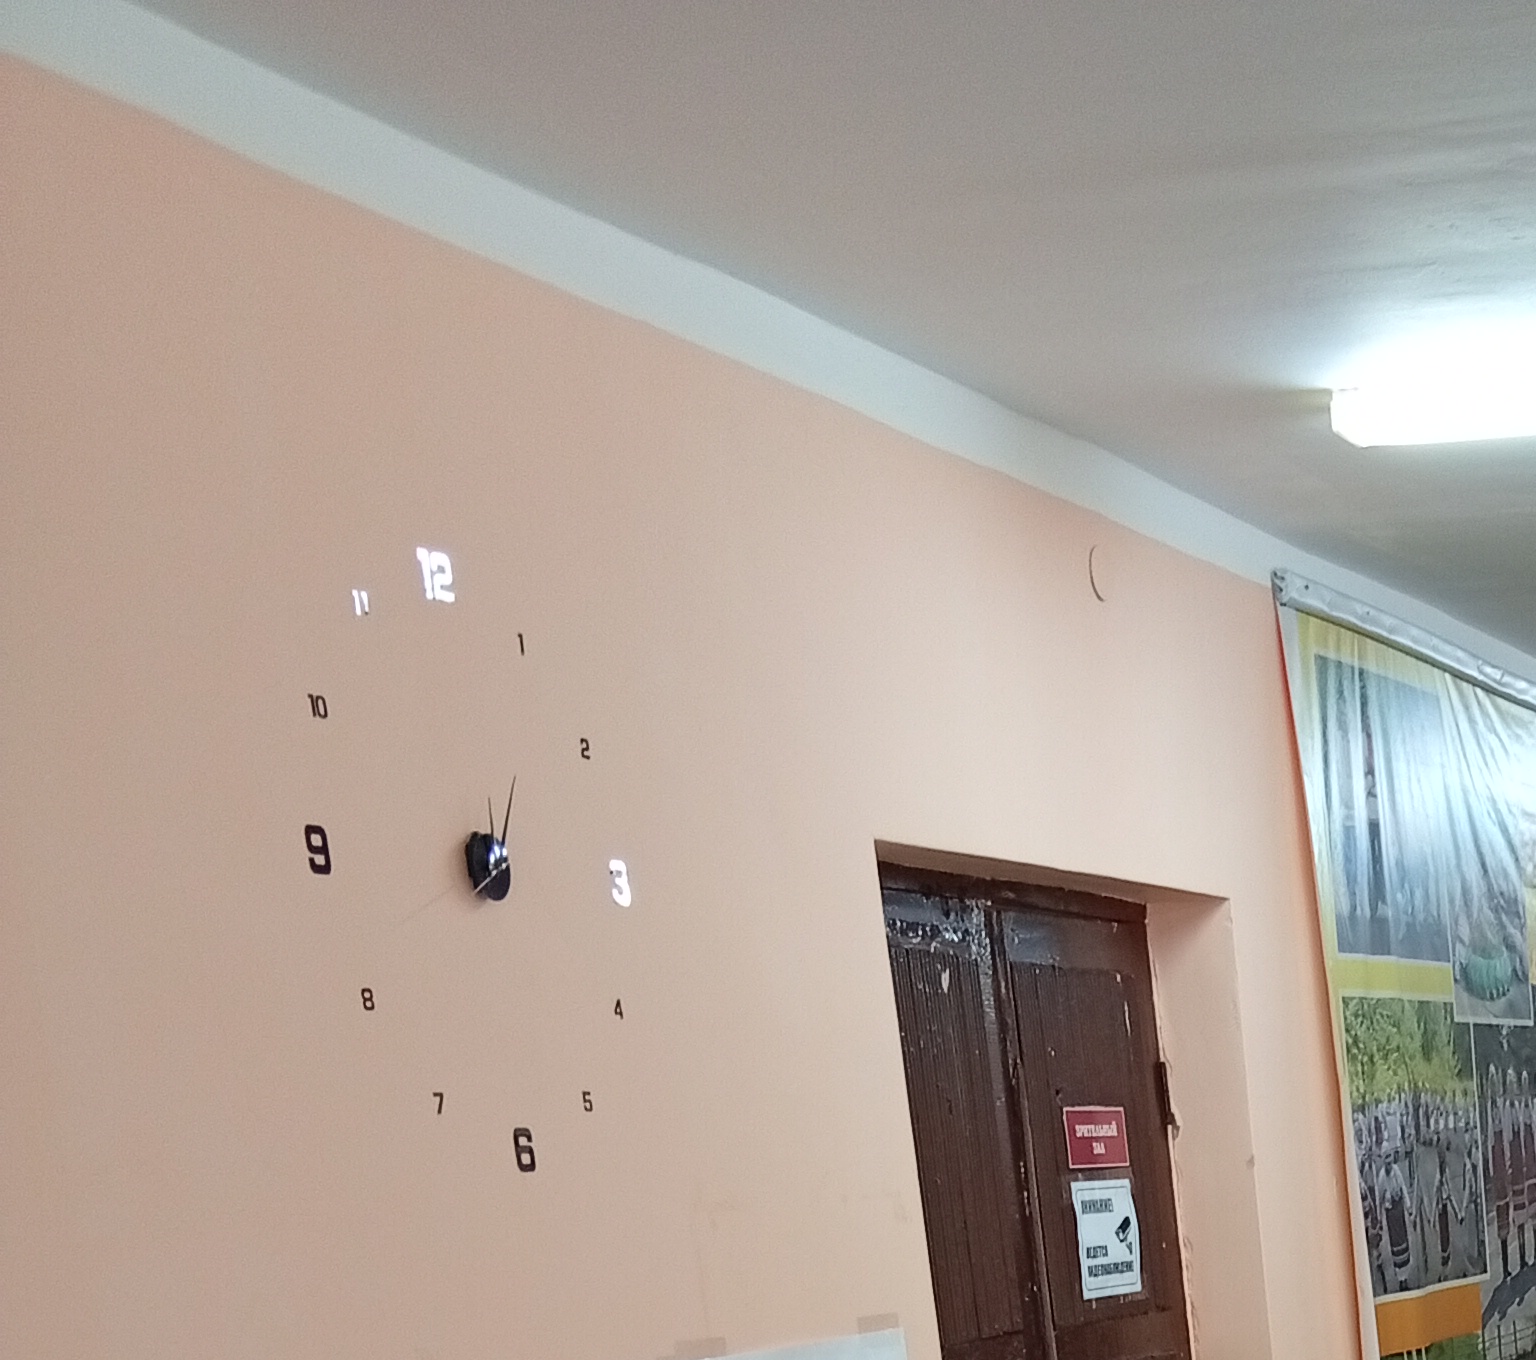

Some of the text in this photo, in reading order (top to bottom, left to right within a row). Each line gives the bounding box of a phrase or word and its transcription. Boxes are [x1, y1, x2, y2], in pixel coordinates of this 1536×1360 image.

[417, 547, 455, 603] 12
[351, 589, 370, 616] 11
[517, 633, 524, 656] 1
[308, 693, 328, 719] 10
[580, 738, 591, 760] 2
[304, 825, 331, 875] 9
[608, 859, 631, 908] 3
[361, 987, 375, 1011] 8
[613, 998, 623, 1020] 4
[433, 1092, 444, 1115] 7
[581, 1091, 593, 1112] 5
[513, 1127, 536, 1172] 6
